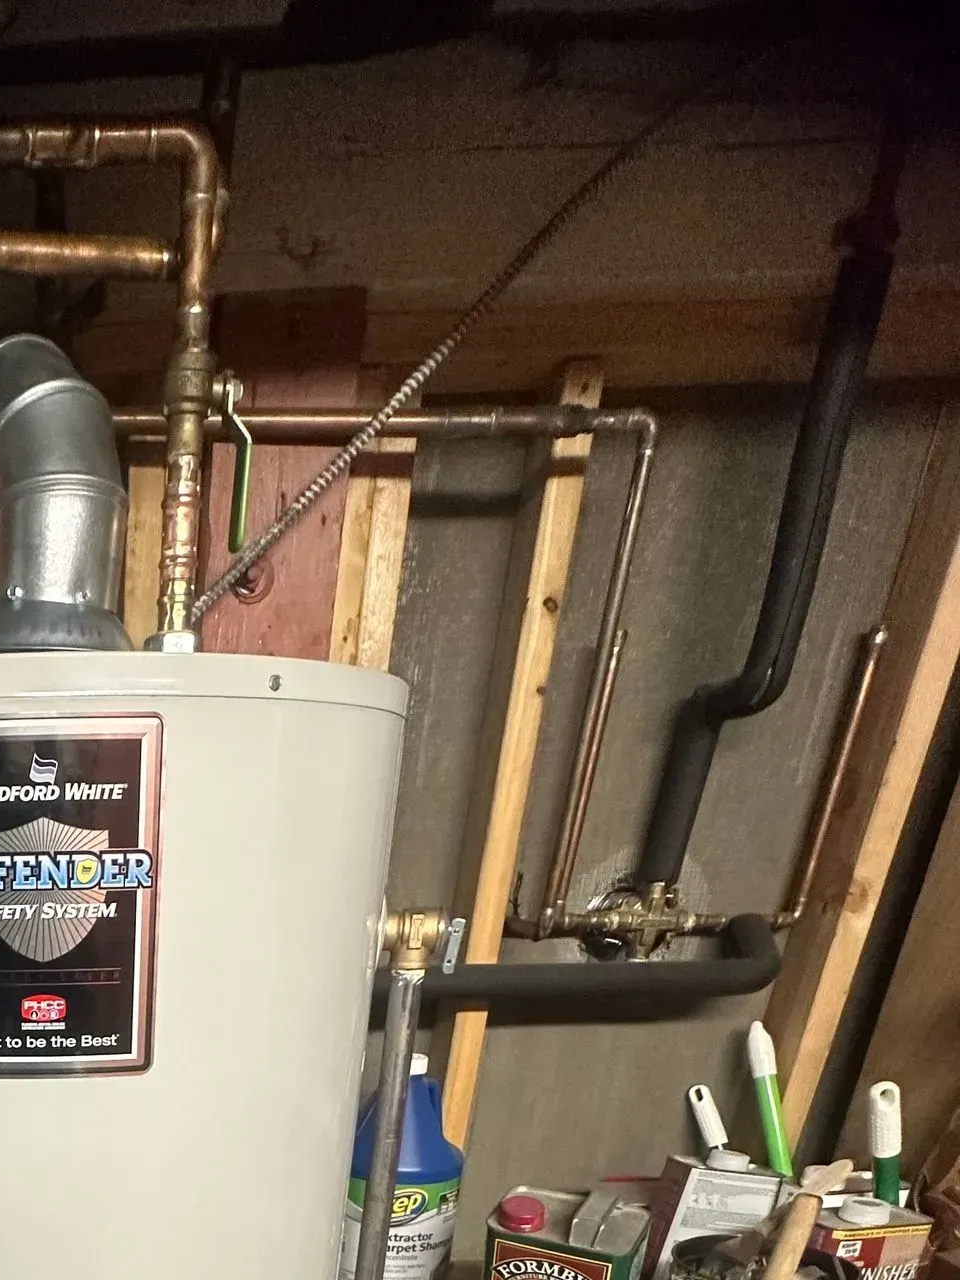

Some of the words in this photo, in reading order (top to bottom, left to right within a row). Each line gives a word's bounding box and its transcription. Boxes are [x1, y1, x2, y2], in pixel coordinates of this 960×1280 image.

[64, 783, 124, 800] WHITE
[42, 902, 116, 919] SYSTEM
[24, 1001, 64, 1010] PHCC
[5, 1037, 22, 1048] to
[26, 1036, 46, 1048] be
[50, 1035, 76, 1047] the
[81, 1034, 117, 1047] Best
[391, 1194, 422, 1217] ep
[388, 1233, 433, 1242] xtractor
[387, 1244, 416, 1254] arpet
